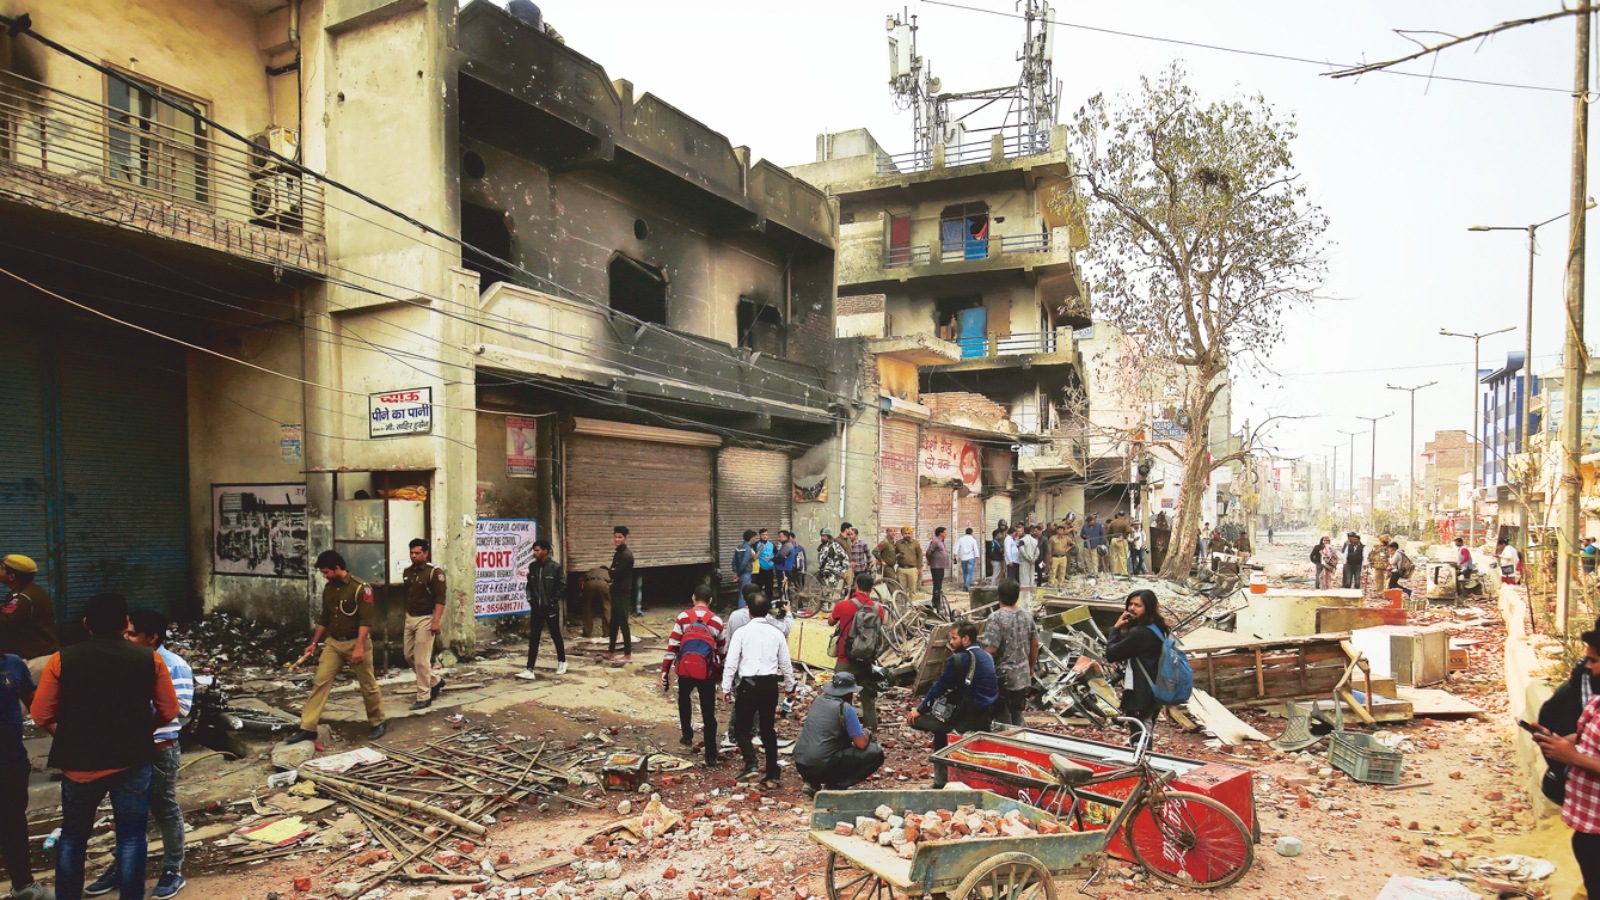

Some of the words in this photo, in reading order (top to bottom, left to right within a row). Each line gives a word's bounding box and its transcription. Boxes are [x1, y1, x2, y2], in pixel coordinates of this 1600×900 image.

[372, 407, 389, 421] पीने
[392, 409, 405, 419] का
[407, 404, 429, 417] पानी
[488, 523, 510, 532] SHERPUR
[511, 523, 530, 532] CHOWK
[502, 536, 517, 546] SCHOOL
